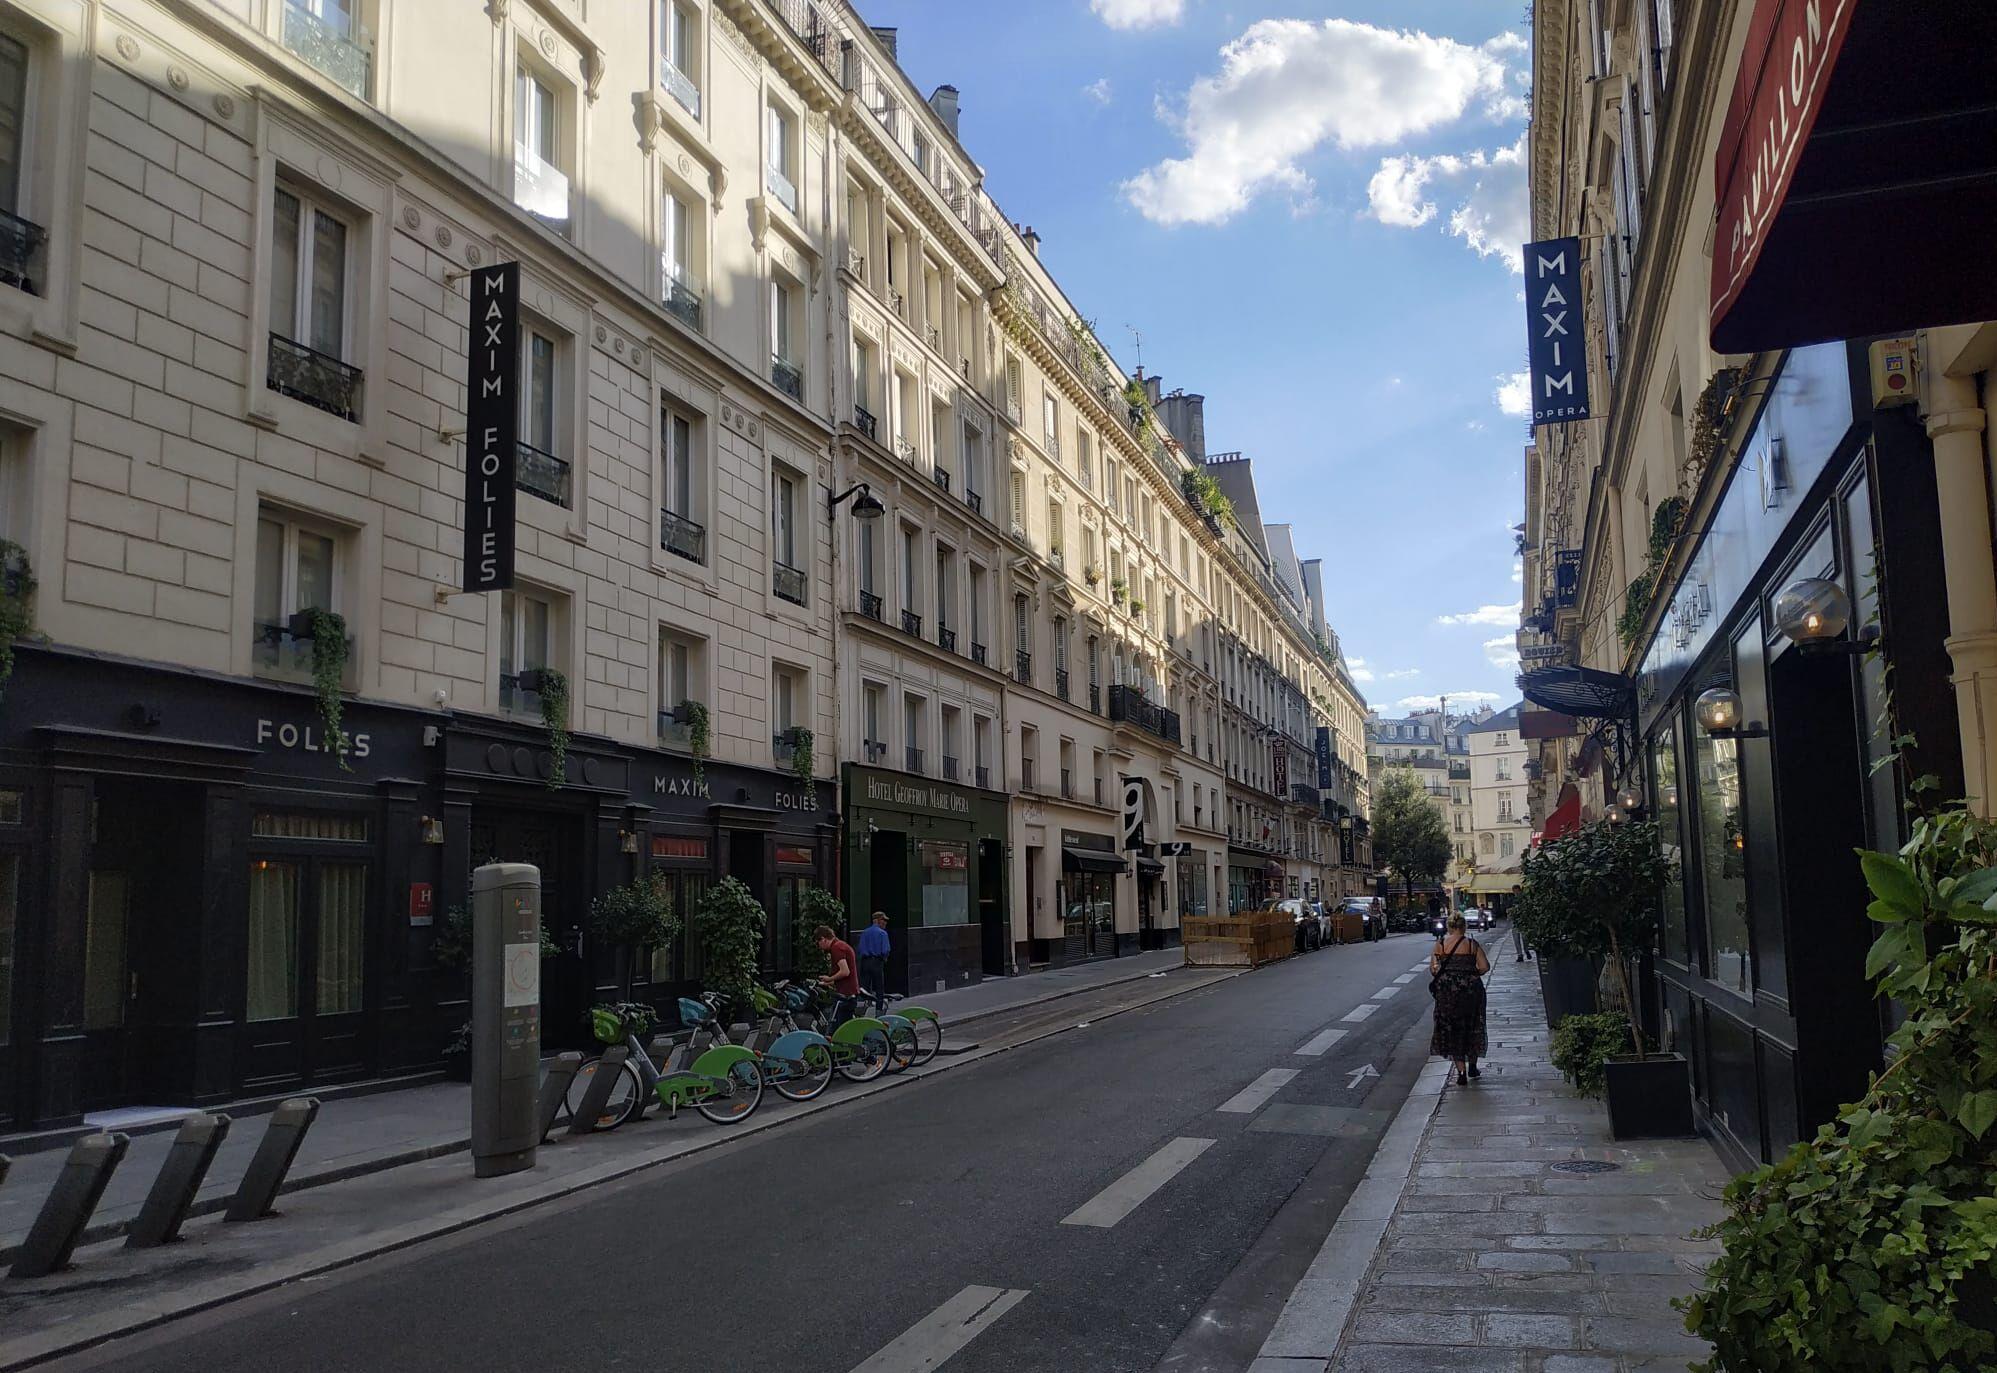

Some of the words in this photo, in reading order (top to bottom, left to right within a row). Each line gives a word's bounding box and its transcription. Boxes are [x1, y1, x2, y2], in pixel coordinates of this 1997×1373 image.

[1729, 0, 1821, 273] PAVILLON
[482, 272, 504, 398] MAXIM
[1538, 250, 1574, 398] MAXIM
[1535, 406, 1587, 420] OPERA
[480, 427, 500, 582] FOLIES
[654, 775, 709, 797] MAXIM
[775, 791, 817, 812] FOLIES
[1123, 782, 1143, 840] 9
[1171, 842, 1184, 856] 9
[421, 889, 431, 902] H
